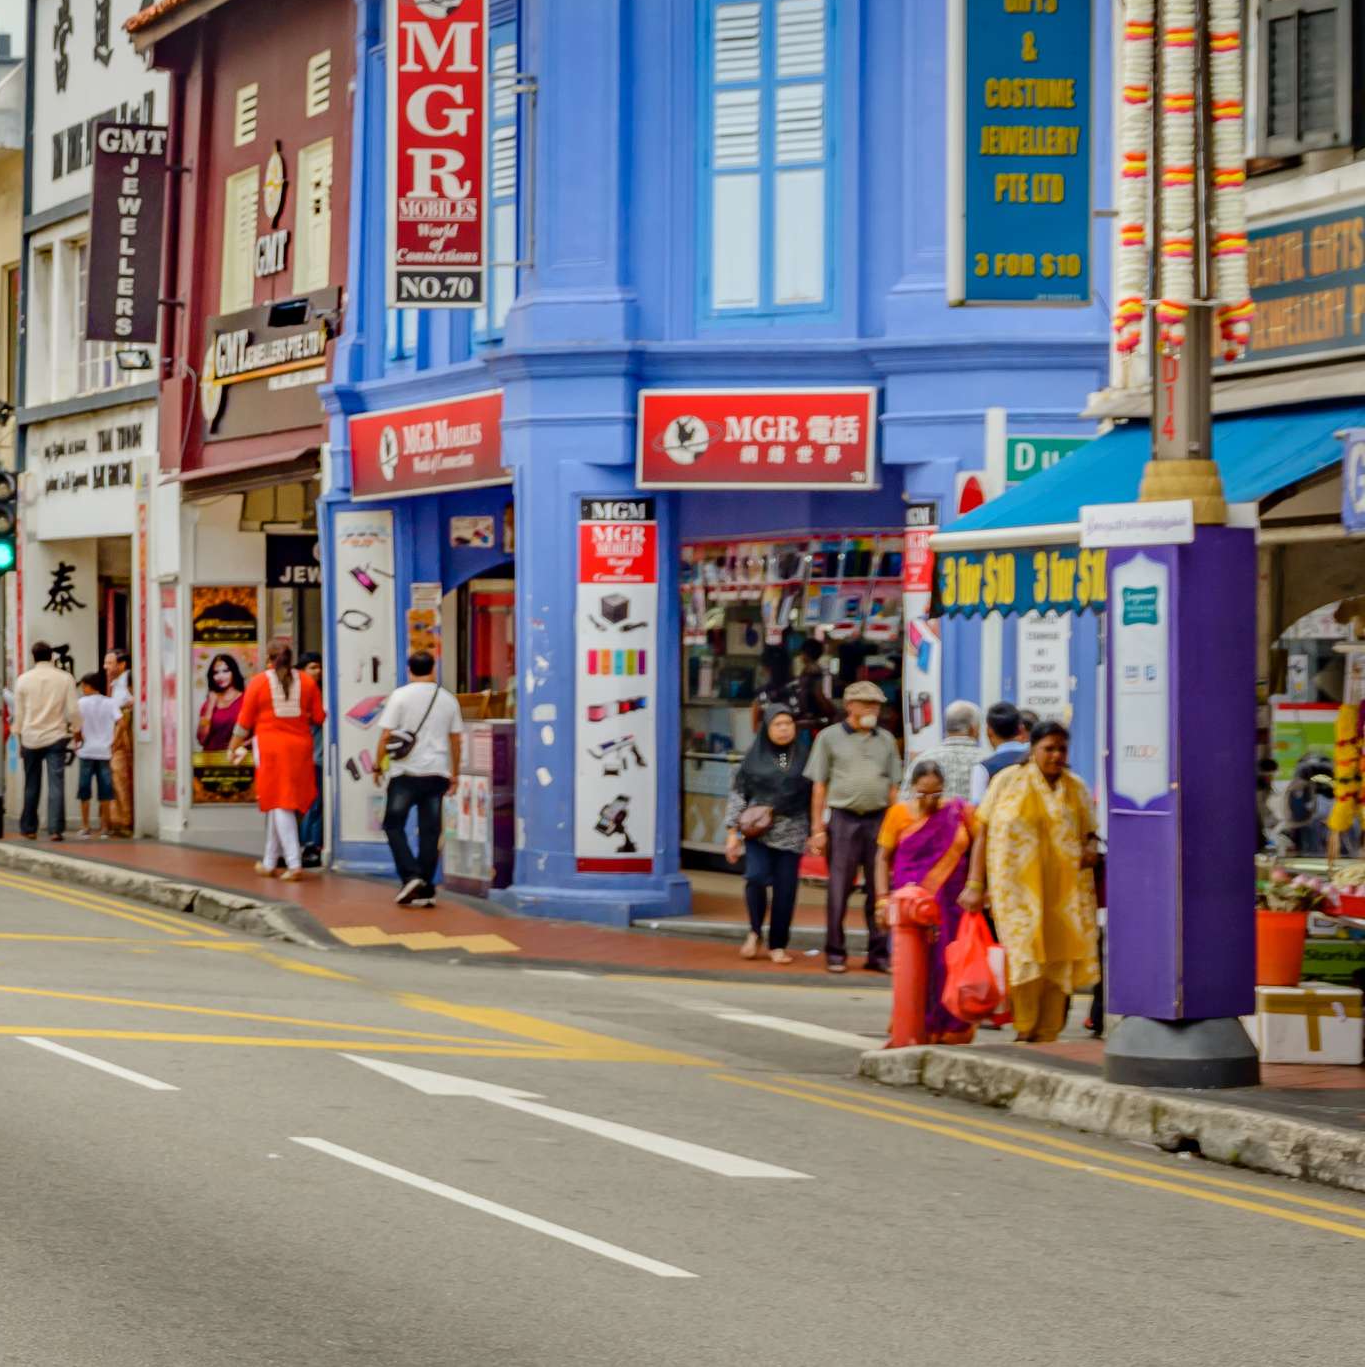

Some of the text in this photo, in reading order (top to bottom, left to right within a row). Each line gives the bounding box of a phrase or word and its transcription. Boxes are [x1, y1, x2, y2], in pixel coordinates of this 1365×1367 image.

[1021, 32, 1038, 61] &
[985, 78, 1076, 108] COSTUME
[400, 22, 478, 200] MGR
[98, 127, 167, 155] GMT
[980, 126, 1080, 156] JEWELLERY
[995, 174, 1064, 203] PTE LTD
[399, 199, 477, 221] MOBILES
[115, 157, 142, 336] JEWELLERS
[255, 229, 288, 278] GMT
[1309, 216, 1364, 277] GIFTS
[975, 253, 1081, 277] 3 FOR $10
[401, 276, 474, 299] NO.70
[216, 329, 248, 378] GMT
[402, 422, 434, 455] MGR
[724, 415, 801, 443] MGR
[591, 502, 646, 520] MGM
[592, 525, 646, 544] MGR
